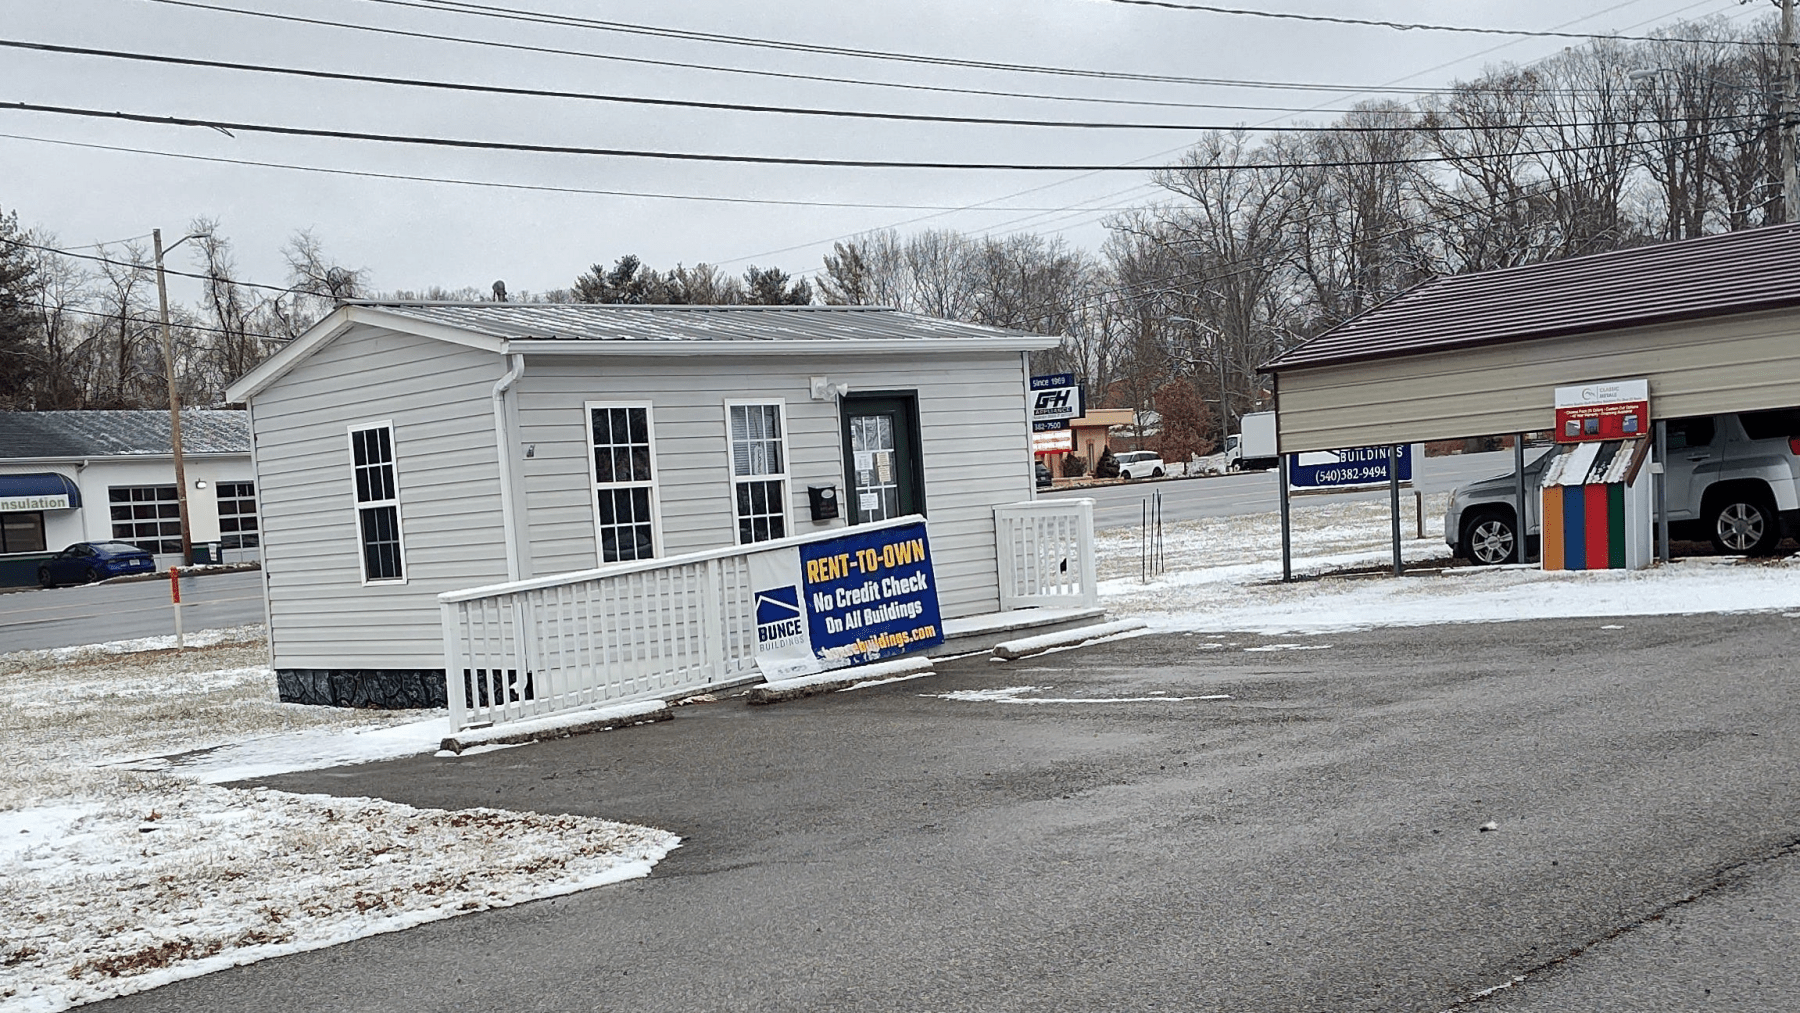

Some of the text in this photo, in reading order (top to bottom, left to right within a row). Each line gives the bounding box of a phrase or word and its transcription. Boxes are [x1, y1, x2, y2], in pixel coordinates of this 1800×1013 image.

[1340, 446, 1404, 463] BUILDINS
[1315, 465, 1387, 484] (540)382-9494
[806, 538, 925, 584] RENT-TO-OWN
[813, 570, 928, 613] No Credit Check
[758, 619, 803, 643] BUNCE
[825, 600, 923, 634] On All Buildings
[759, 634, 805, 652] BUILDINGS
[818, 625, 936, 658] ebuildings.com
